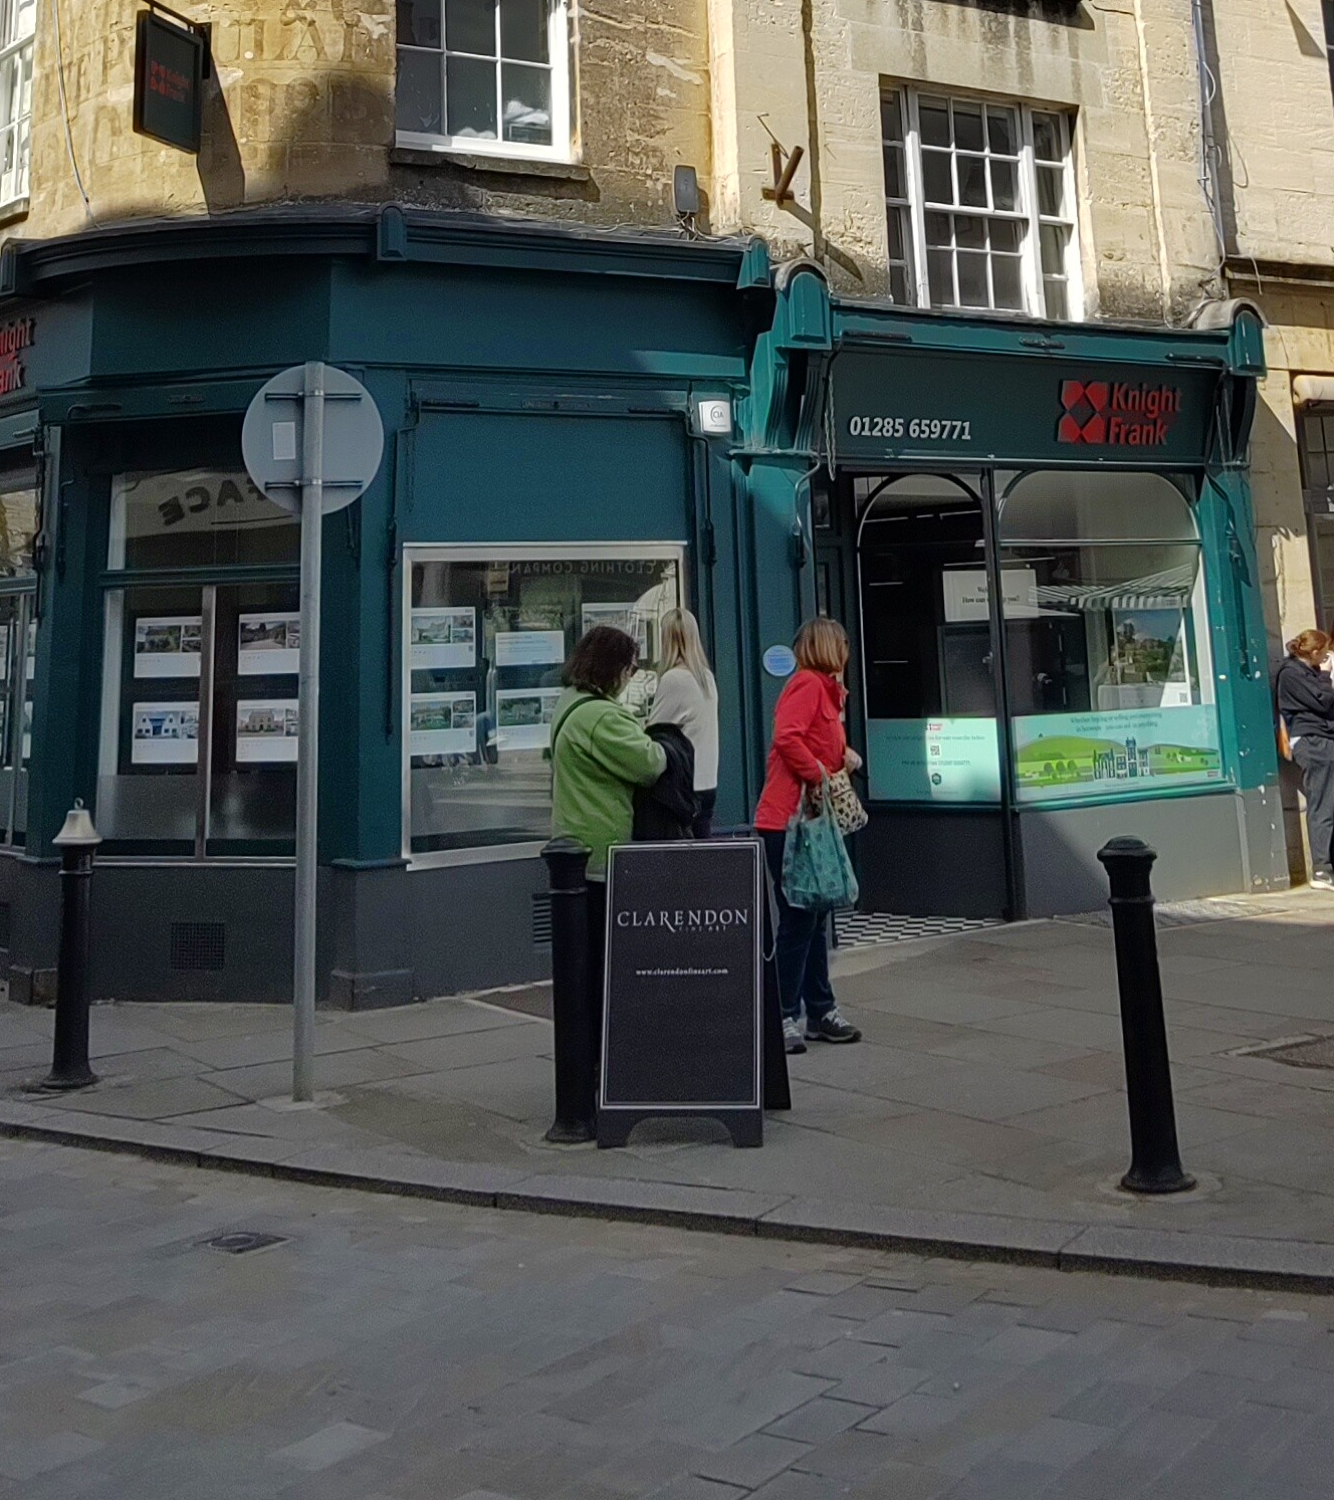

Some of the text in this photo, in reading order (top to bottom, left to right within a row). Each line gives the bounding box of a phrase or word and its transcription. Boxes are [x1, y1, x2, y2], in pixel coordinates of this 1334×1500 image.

[1111, 382, 1183, 419] Knight
[849, 416, 971, 440] 01285 659771
[1108, 416, 1169, 445] Frank
[617, 909, 748, 933] CLARENDON
